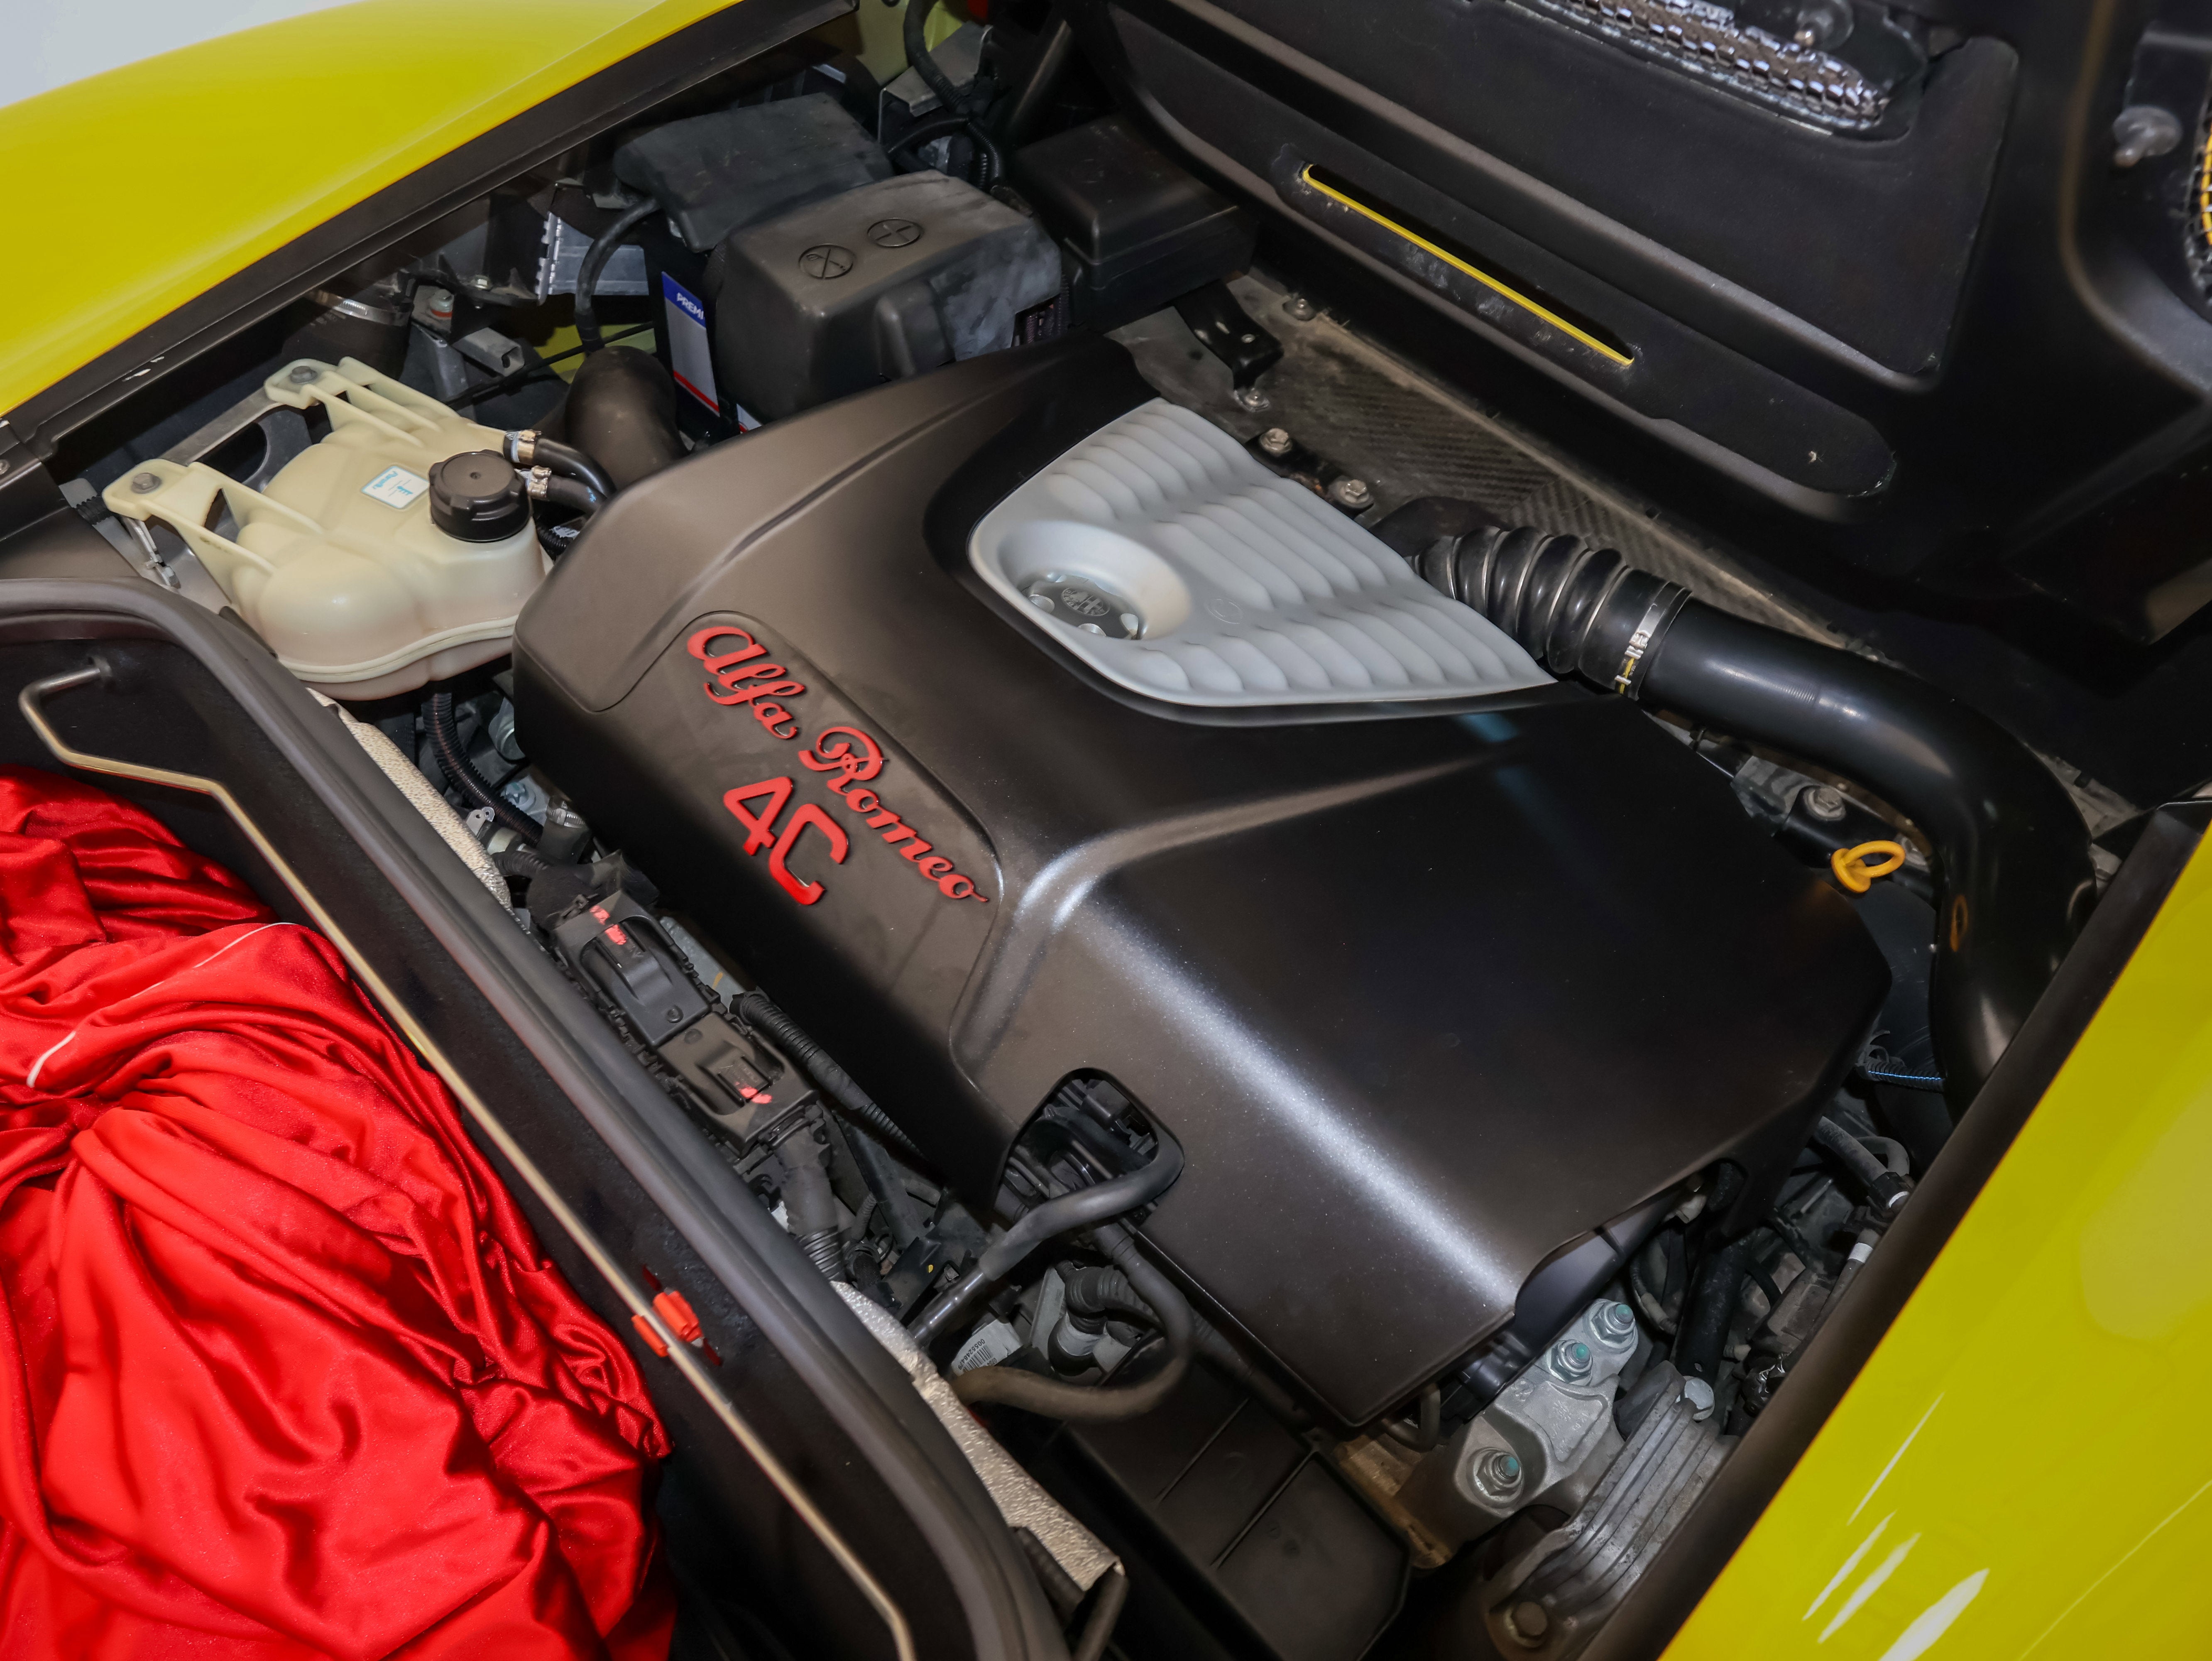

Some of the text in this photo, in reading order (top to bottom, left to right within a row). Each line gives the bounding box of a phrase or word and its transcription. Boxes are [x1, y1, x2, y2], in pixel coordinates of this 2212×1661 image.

[687, 626, 989, 903] Alfa Romeo
[723, 776, 848, 906] 4C
